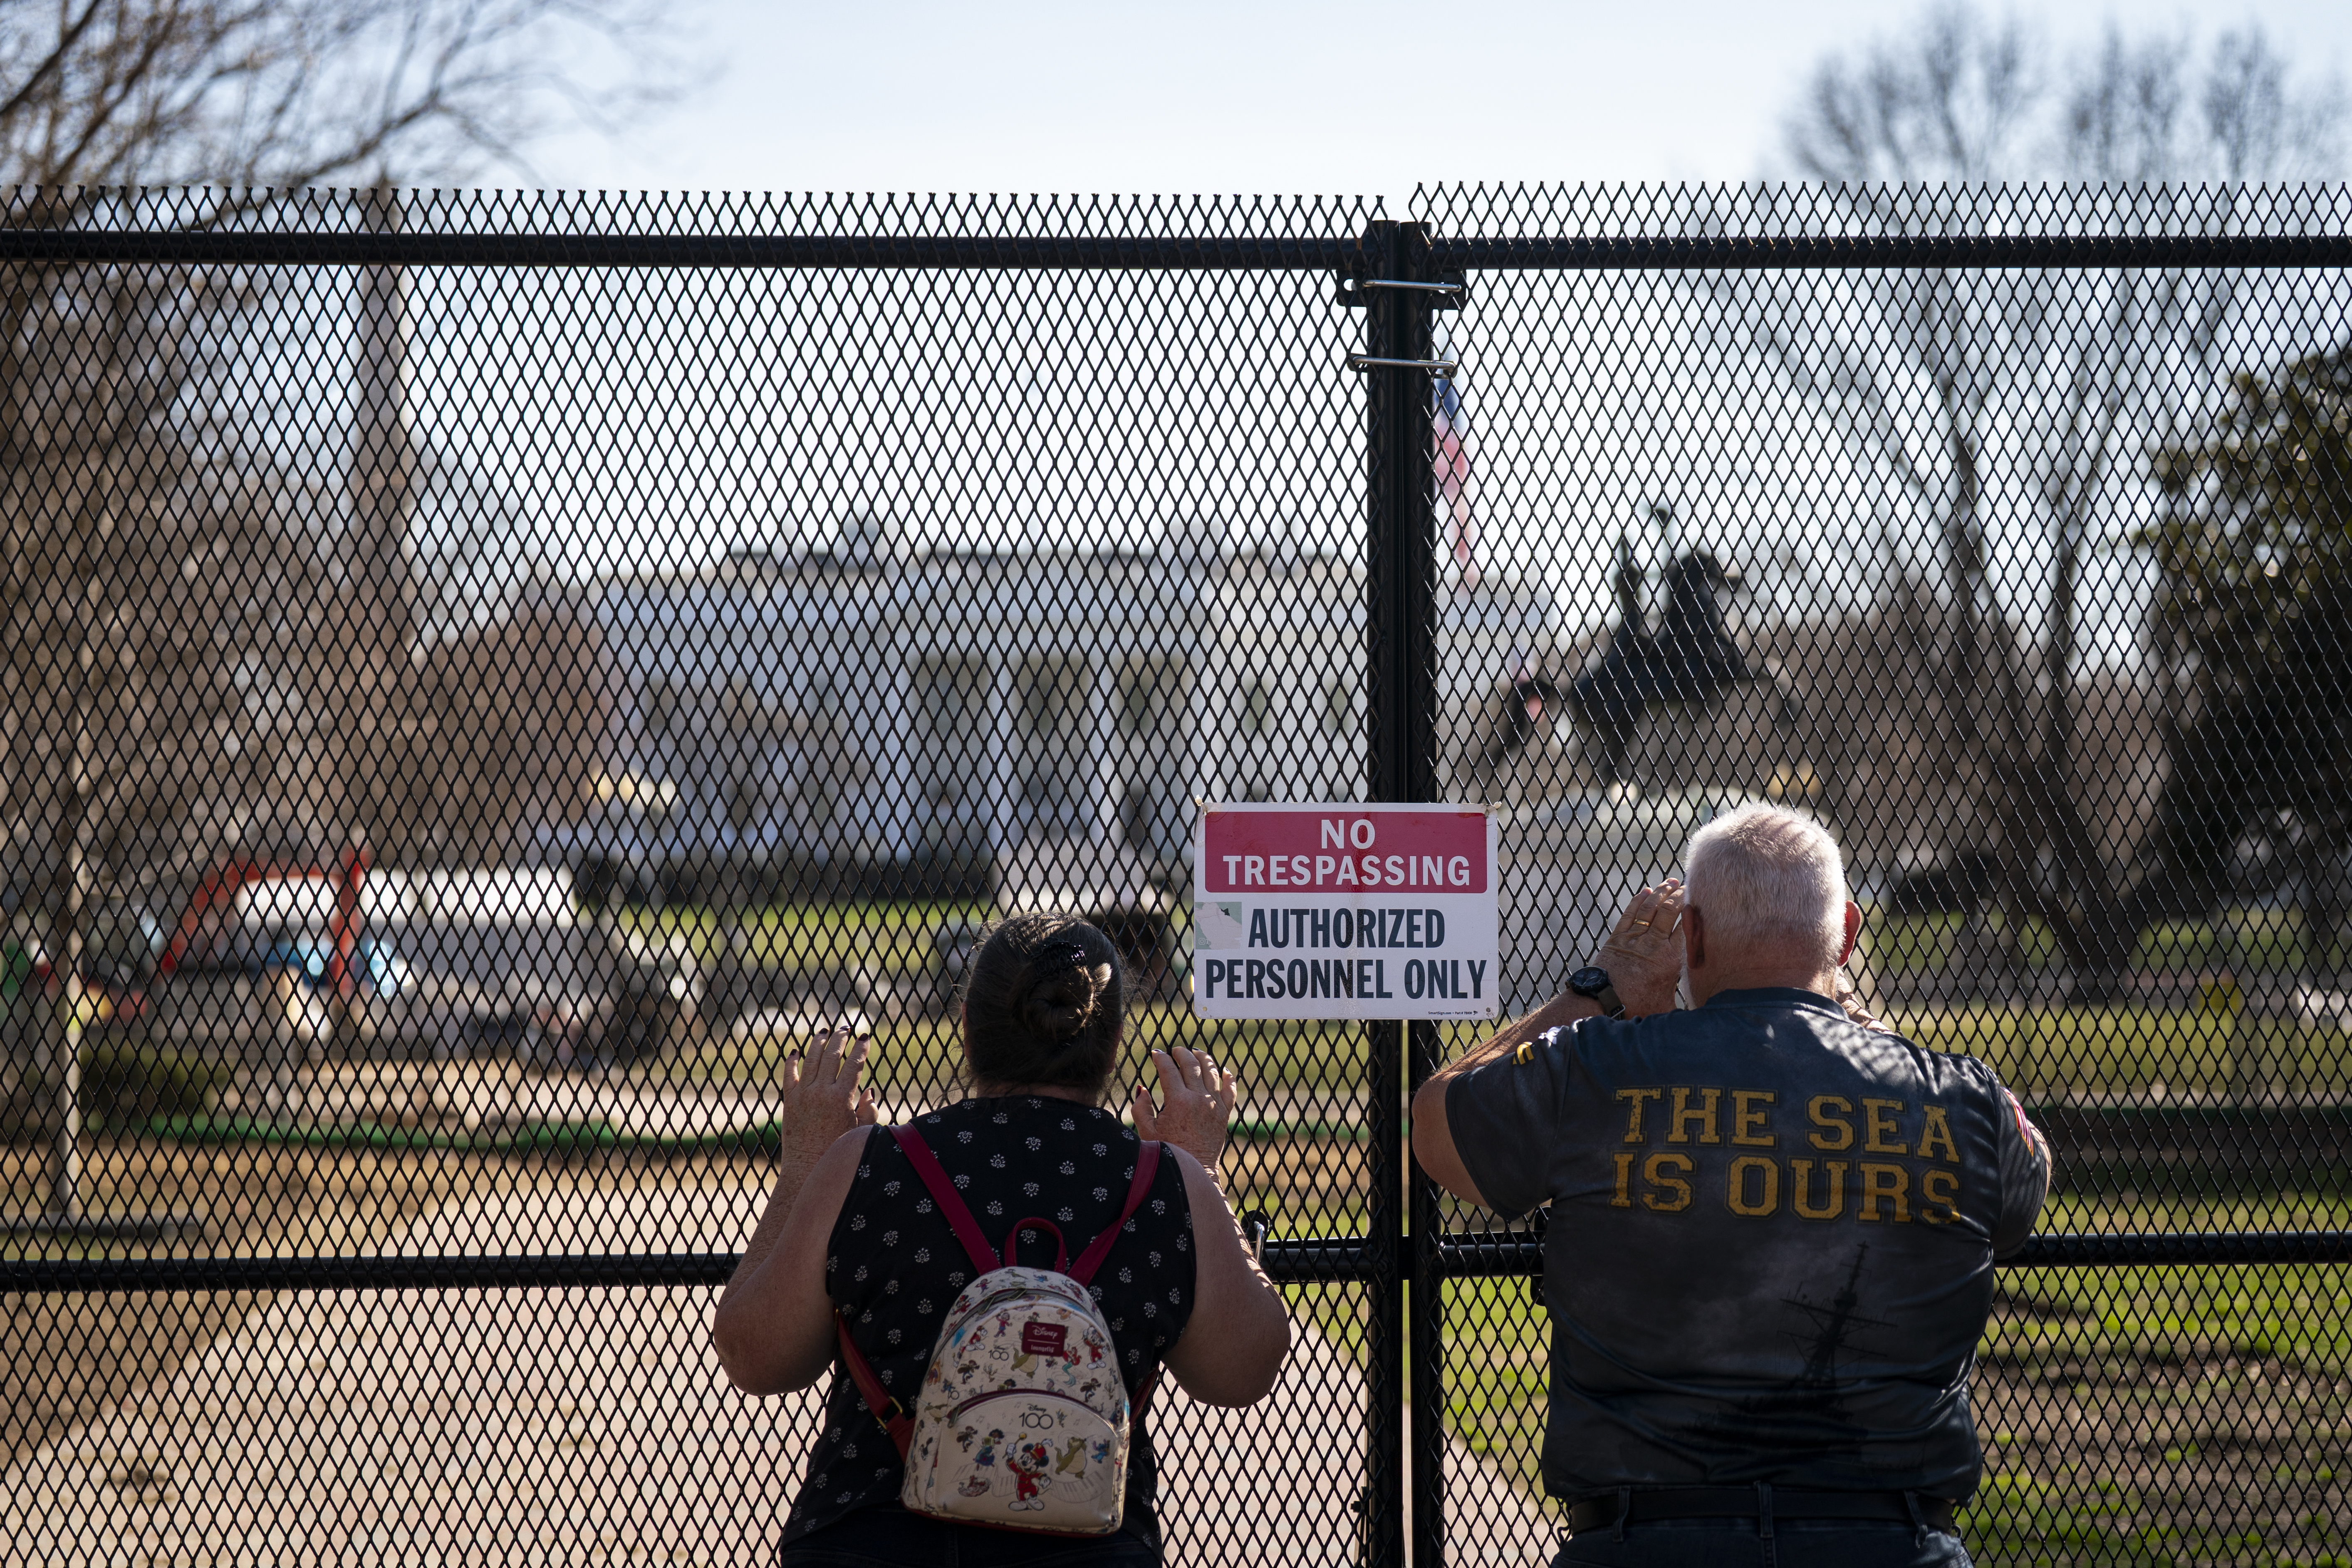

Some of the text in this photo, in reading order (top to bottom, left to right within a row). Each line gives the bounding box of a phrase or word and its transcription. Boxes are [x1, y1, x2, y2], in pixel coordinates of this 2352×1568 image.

[1321, 819, 1376, 849] NO
[1223, 855, 1470, 886] TRESPASSING
[1248, 908, 1445, 949] AUTHORIZED
[1206, 959, 1487, 999] PERSONNEL ONLY
[1613, 1085, 1962, 1166] THE SEA
[1609, 1151, 1961, 1226] IS OURS
[988, 1350, 1009, 1361] 100
[1031, 1344, 1054, 1353] loungefly
[1019, 1412, 1053, 1429] 100
